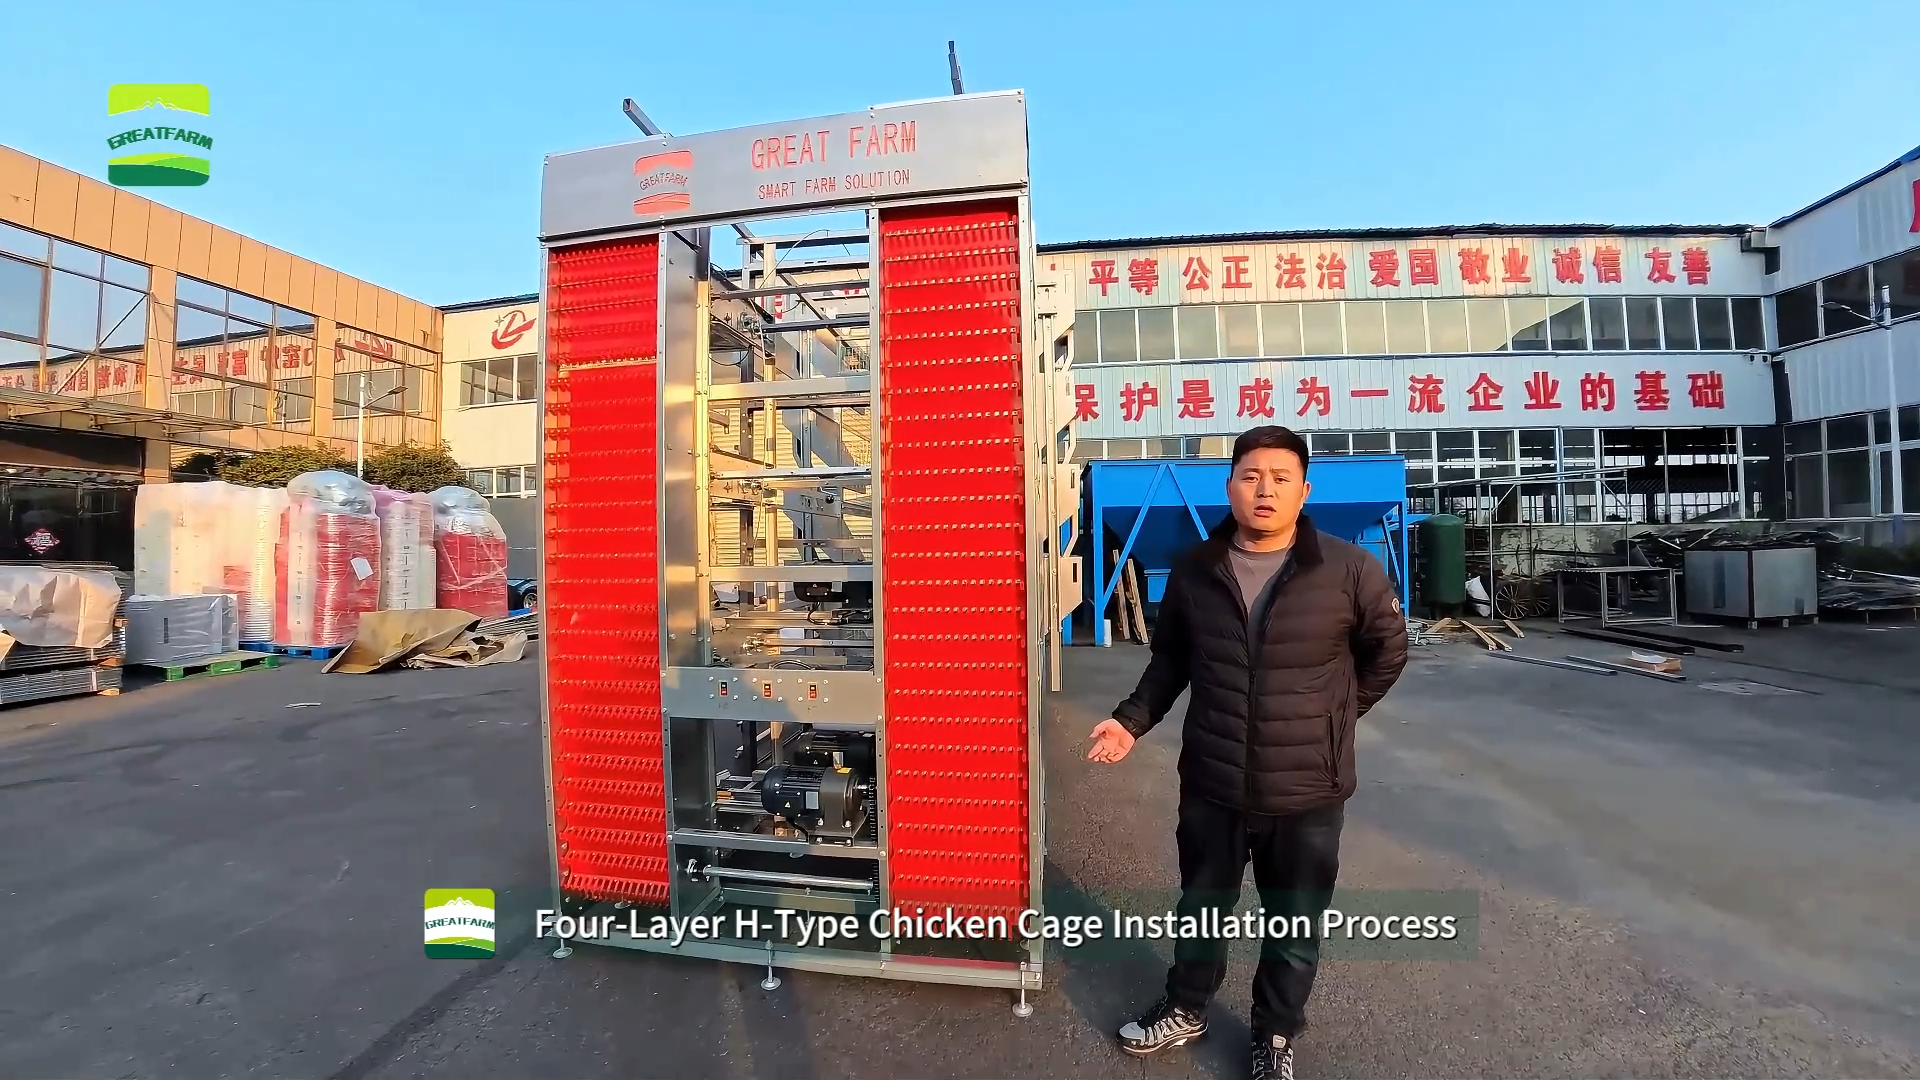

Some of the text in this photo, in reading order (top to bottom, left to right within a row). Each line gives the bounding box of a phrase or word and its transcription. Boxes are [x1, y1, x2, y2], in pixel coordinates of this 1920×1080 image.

[752, 121, 916, 170] GREAT FARM
[640, 172, 689, 190] GREATFARM
[759, 169, 910, 199] SMART FARM SOLUTION
[1089, 246, 1711, 296] 平等 公正 法治 爱国 敬业 诚信 友善
